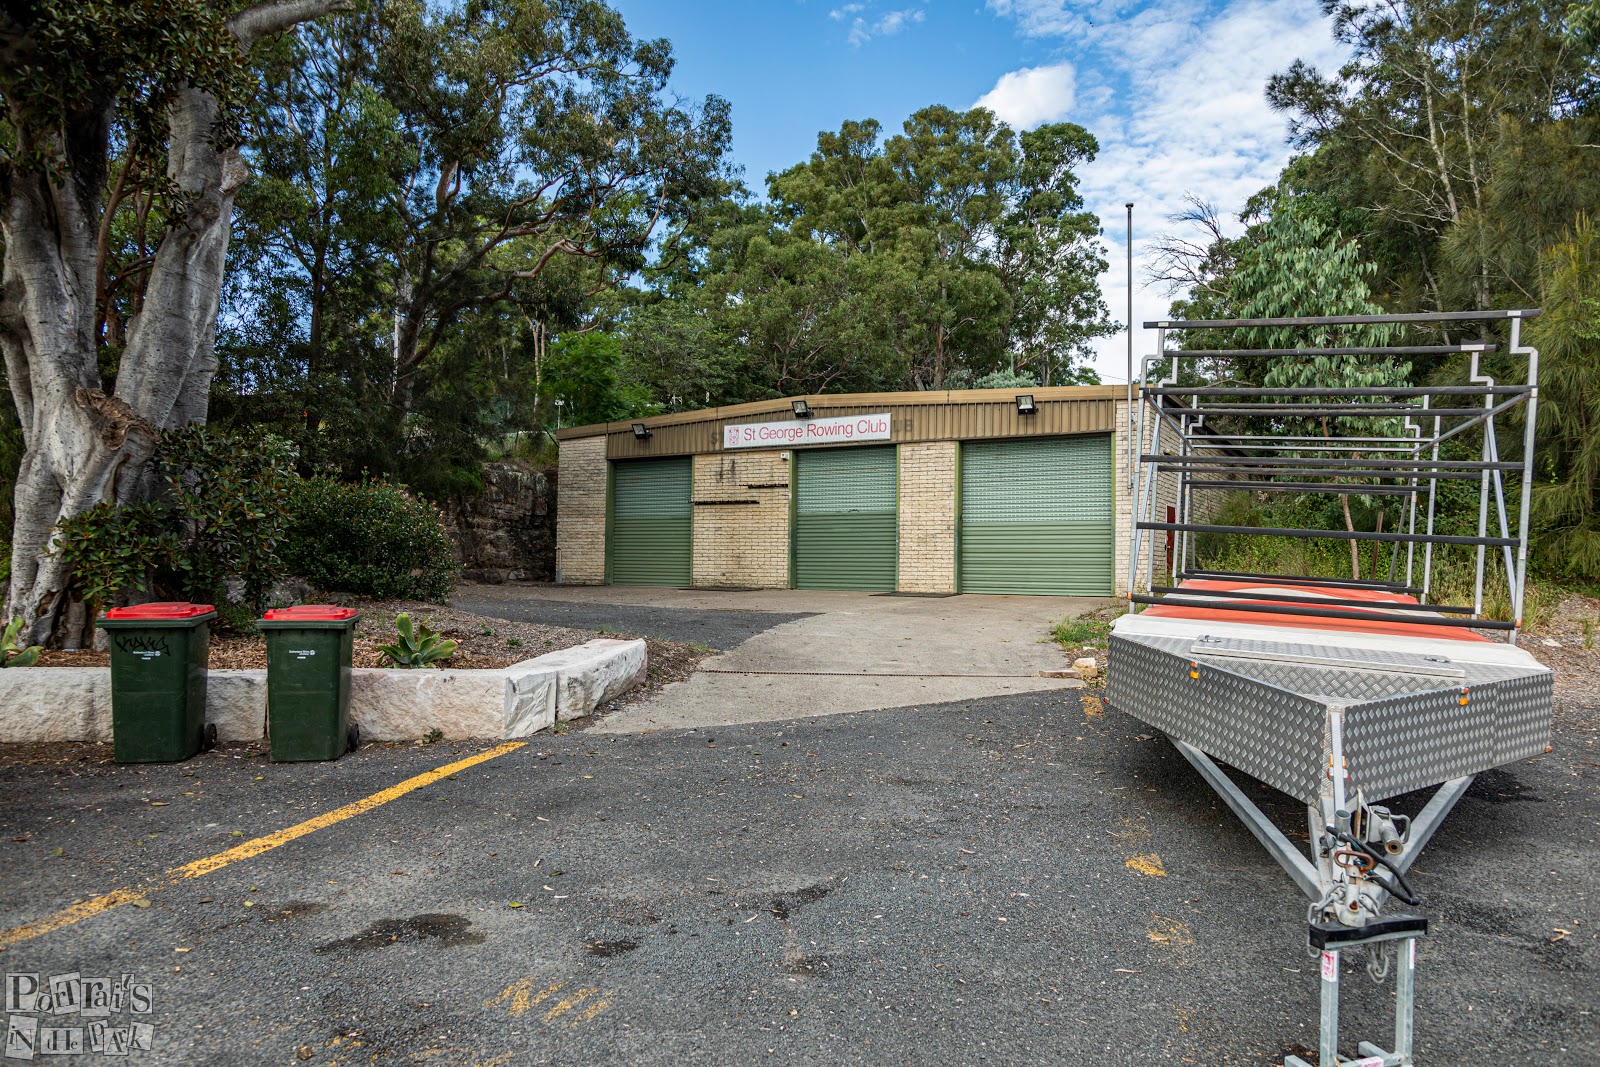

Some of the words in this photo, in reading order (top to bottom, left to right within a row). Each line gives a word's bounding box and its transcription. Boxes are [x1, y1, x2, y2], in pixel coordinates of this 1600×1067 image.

[743, 427, 756, 441] St
[758, 426, 803, 442] George
[806, 422, 853, 439] Rowing
[857, 419, 887, 434] Club
